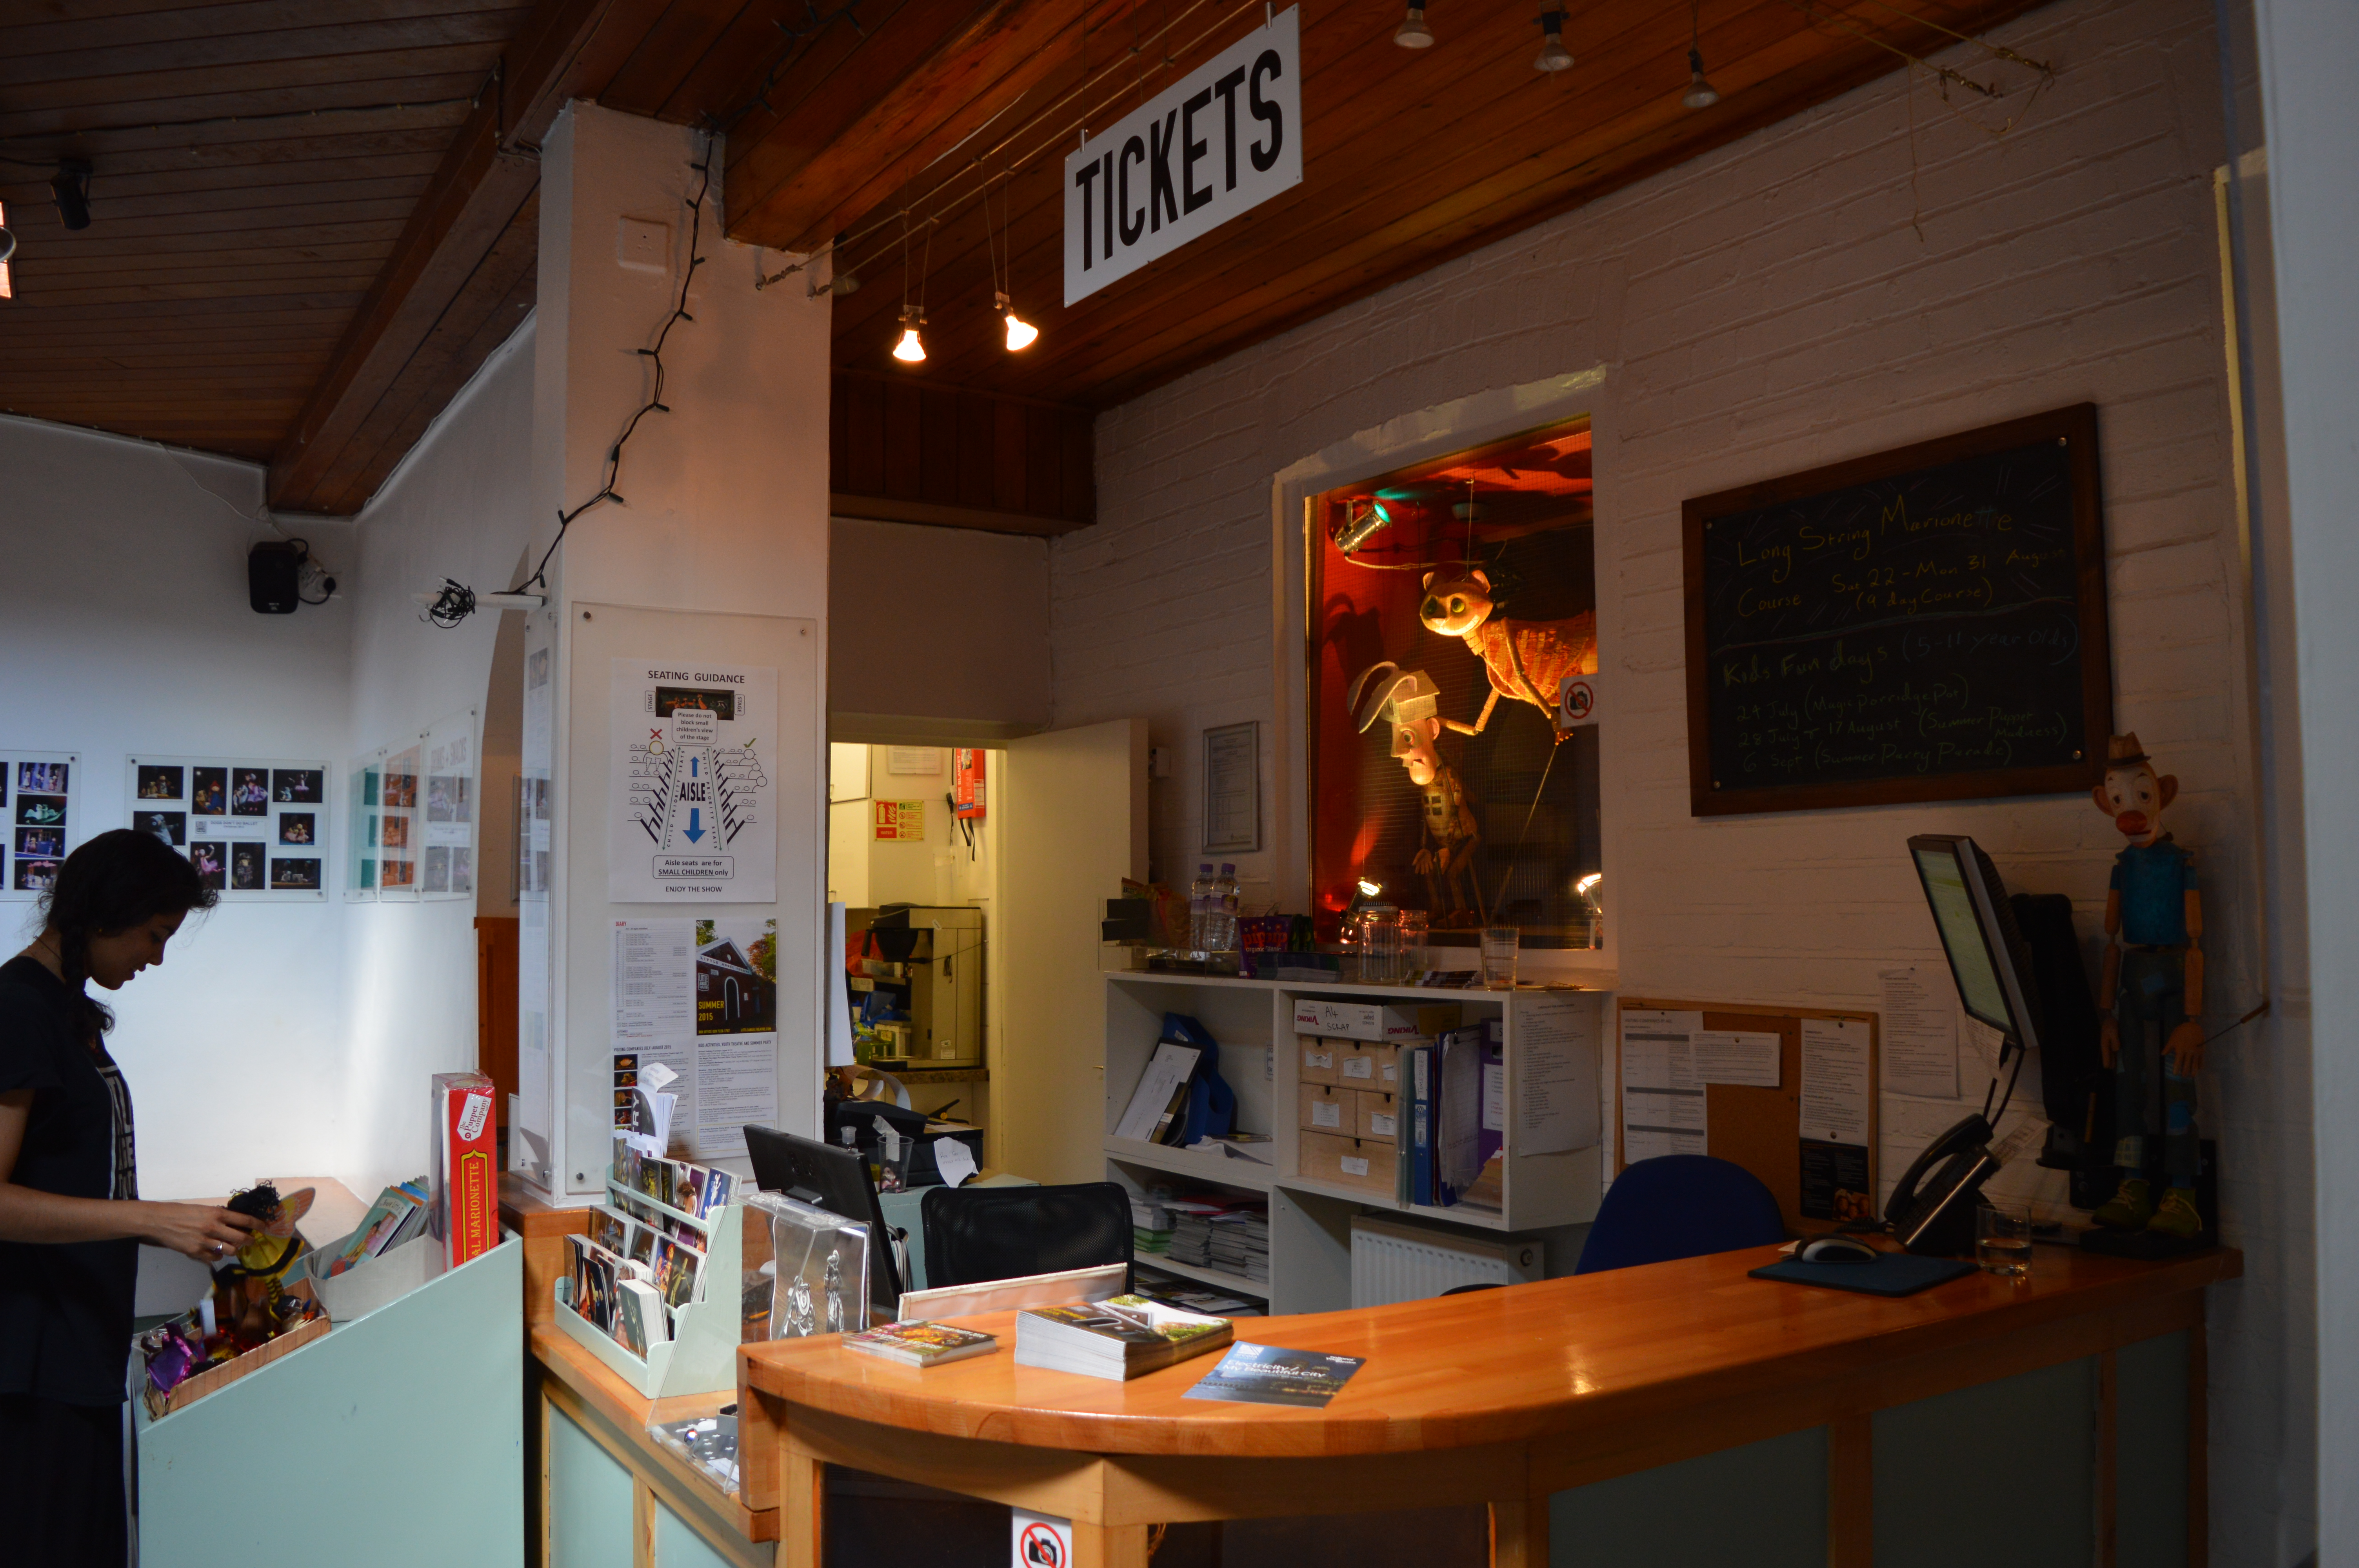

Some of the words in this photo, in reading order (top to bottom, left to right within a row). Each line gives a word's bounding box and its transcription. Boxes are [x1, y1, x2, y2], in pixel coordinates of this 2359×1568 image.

[1076, 49, 1283, 272] TICKETS
[1739, 542, 1790, 583] Long
[1799, 526, 1870, 560] String
[1881, 494, 2012, 535] Marionette
[1832, 574, 1860, 592] Sat
[1867, 567, 1895, 587] 22
[1916, 561, 1958, 578] Mon
[1968, 555, 1986, 570] 31
[1738, 588, 1801, 617] Course
[1887, 591, 1917, 614] day
[1921, 576, 1992, 608] Course)
[1724, 654, 1770, 688] Kids
[1781, 652, 1819, 679] Fun
[1969, 633, 2020, 653] year
[648, 670, 689, 680] SEATING
[694, 673, 745, 683] GUIDANCE
[1737, 705, 1760, 722] 24
[1767, 701, 1798, 730] July
[1805, 684, 1852, 720] (Magic
[1738, 732, 1761, 748] 28
[1768, 728, 1799, 750] July
[1829, 721, 1842, 734] 17
[1848, 718, 1901, 740] August
[1919, 708, 1984, 737] (Summer
[1986, 706, 2033, 730] Puppet
[1743, 752, 1756, 772] 6
[1771, 754, 1802, 773] Sept
[1815, 740, 1875, 770] (Summer
[1882, 744, 1930, 772] Party
[1937, 739, 2012, 766] Parade)
[672, 779, 680, 817] PRIORITY
[679, 782, 706, 801] AISLE
[698, 1000, 724, 1009] SUMMER
[698, 1013, 713, 1021] 2015
[1325, 1006, 1338, 1018] A4
[1297, 1015, 1319, 1025] VIKING
[1327, 1022, 1349, 1031] SCRAP
[1388, 1025, 1419, 1034] VIKING
[464, 1105, 478, 1132] Puppet
[472, 1098, 489, 1133] Company
[470, 1162, 480, 1238] MARIONETTE
[1228, 1359, 1289, 1372] Electricity
[1244, 1366, 1299, 1376] Beautiful
